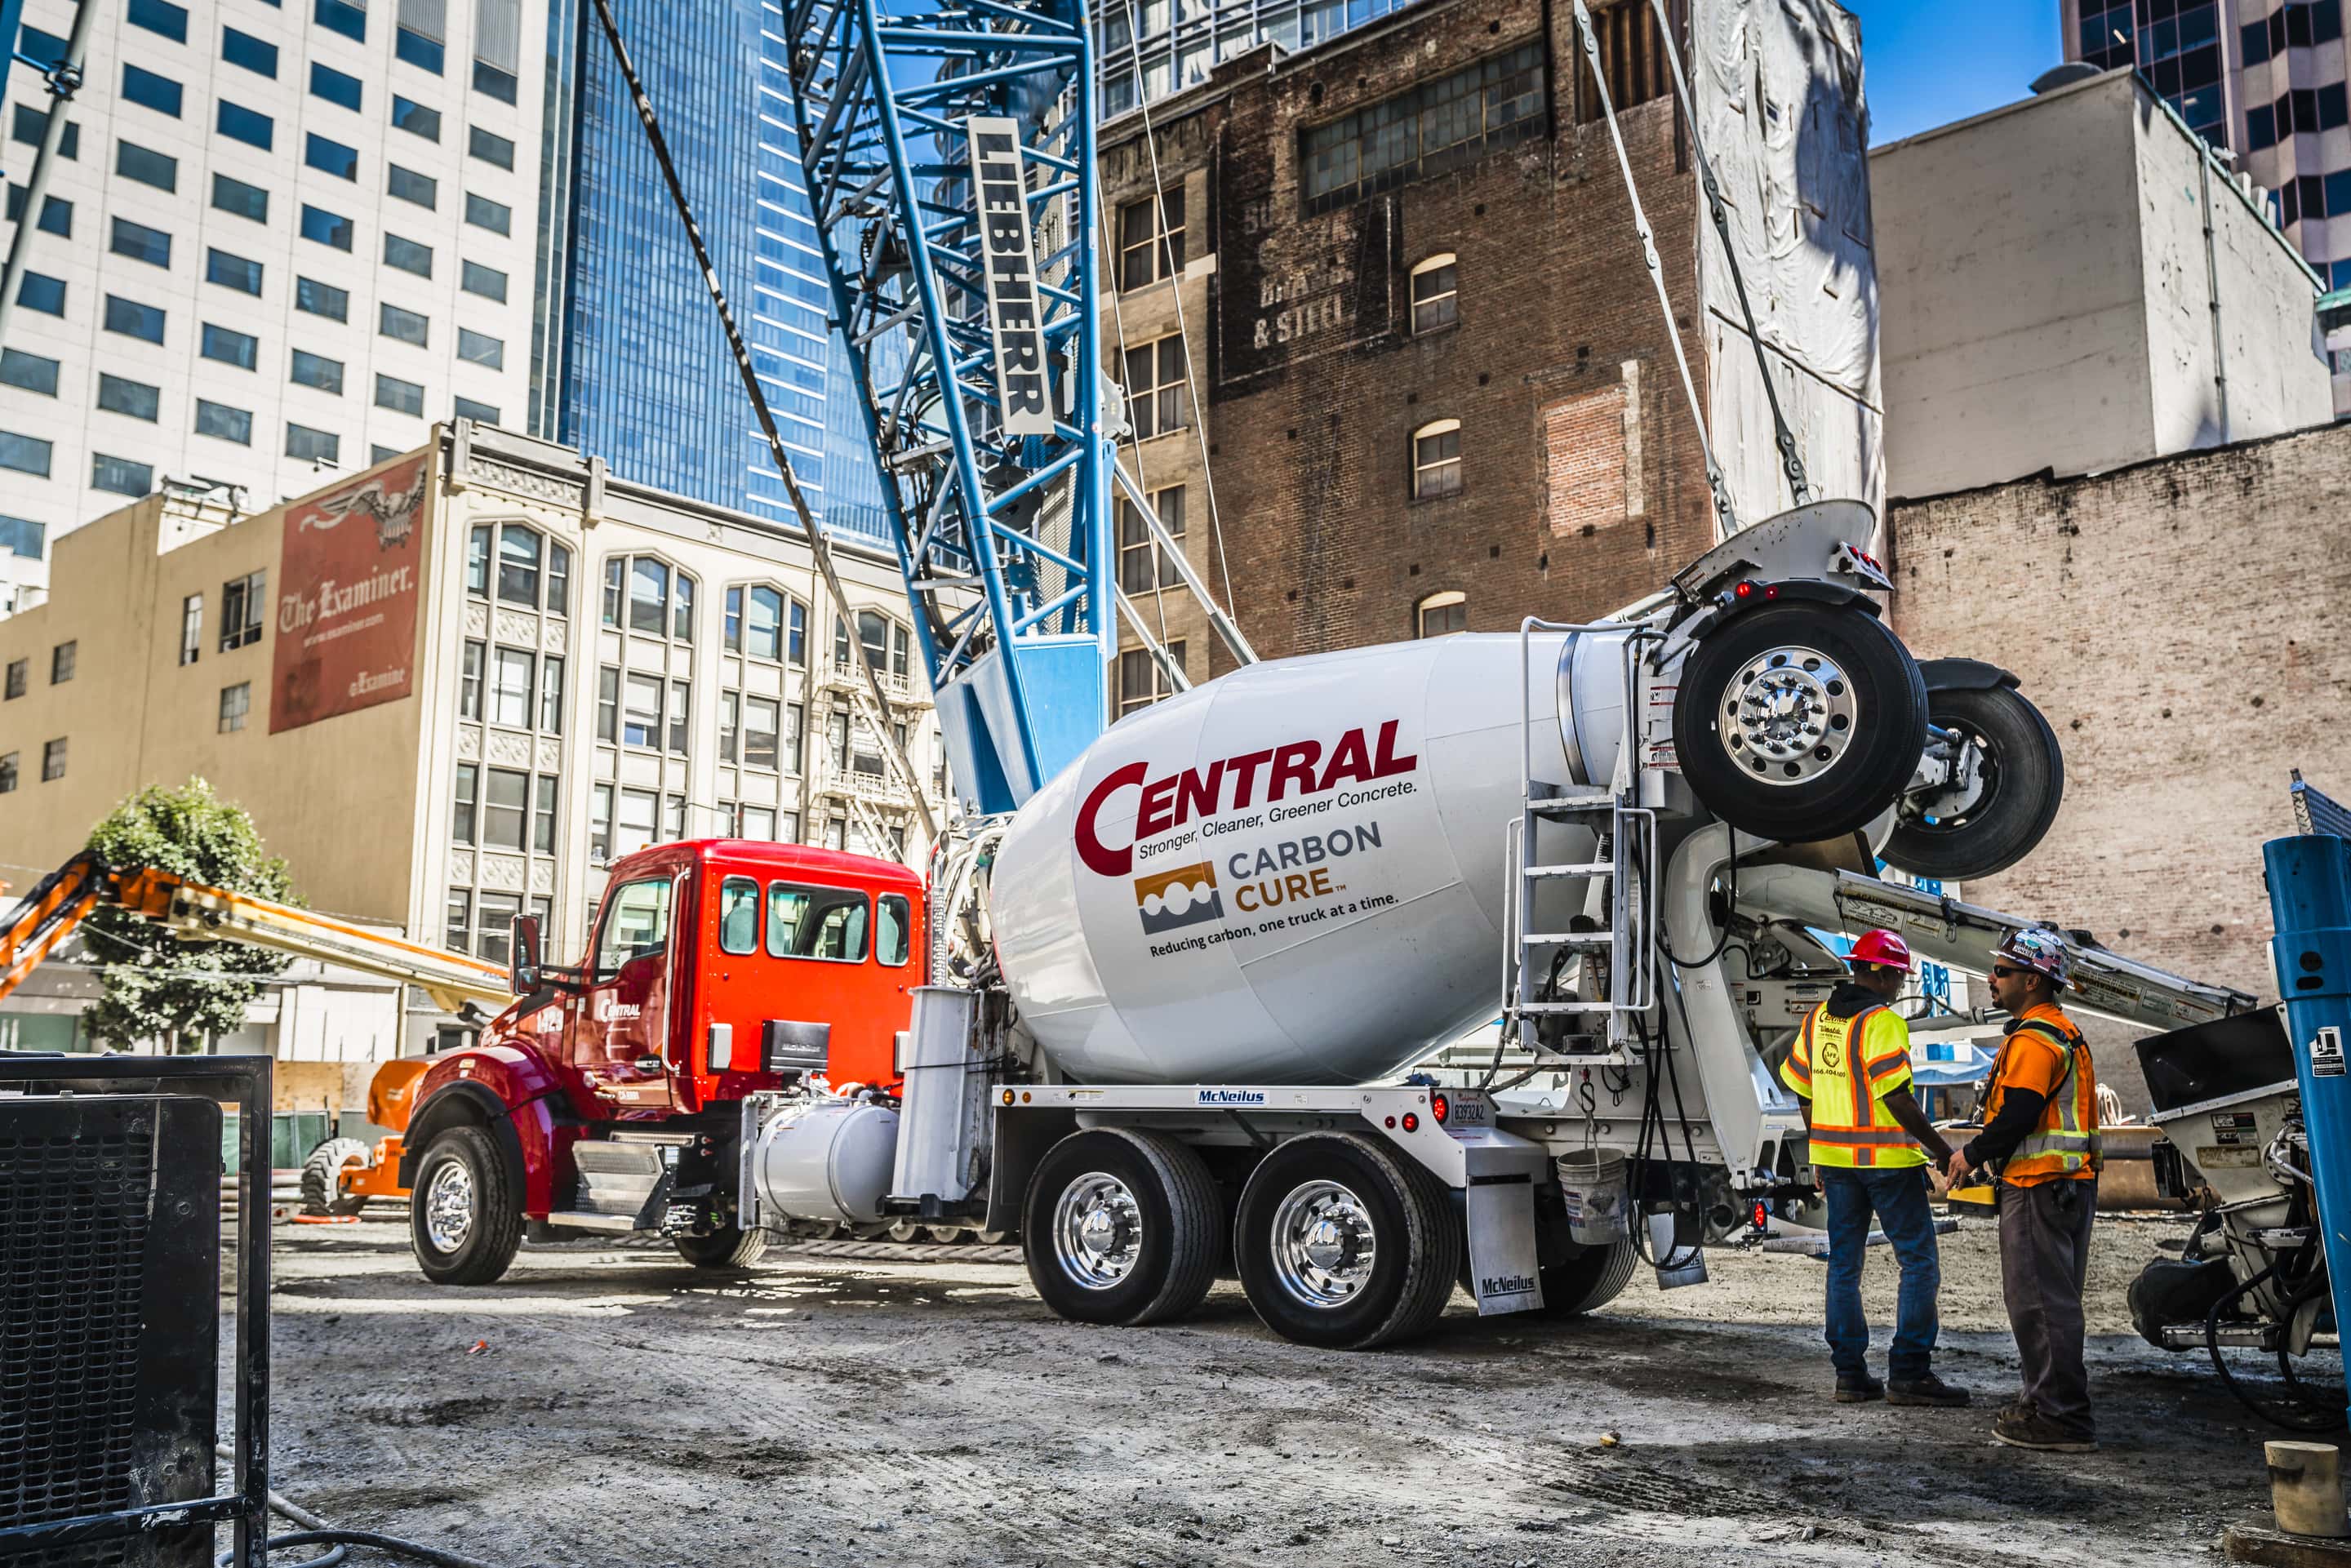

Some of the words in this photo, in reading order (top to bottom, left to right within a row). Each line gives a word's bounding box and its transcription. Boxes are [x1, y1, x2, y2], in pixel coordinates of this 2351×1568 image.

[976, 134, 1045, 418] LIEBHERR
[279, 593, 316, 633] The
[1074, 718, 1418, 877] CENTRAL
[1140, 830, 1198, 860] Stronger,
[1202, 815, 1264, 837] Cleaner,
[1269, 798, 1334, 823] Greener
[1338, 781, 1418, 808] Concrete.
[1229, 821, 1382, 880] CARBON
[1149, 937, 1207, 957] Reducing
[1208, 926, 1257, 944] carbon,
[1259, 919, 1286, 933] one
[1287, 908, 1327, 926] truck
[1330, 904, 1345, 917] at
[1349, 902, 1358, 913] a
[1360, 894, 1399, 910] time.
[600, 998, 641, 1023] CENTRAL
[1198, 1090, 1264, 1104] McNeilus
[1482, 1275, 1535, 1295] McNeilus
